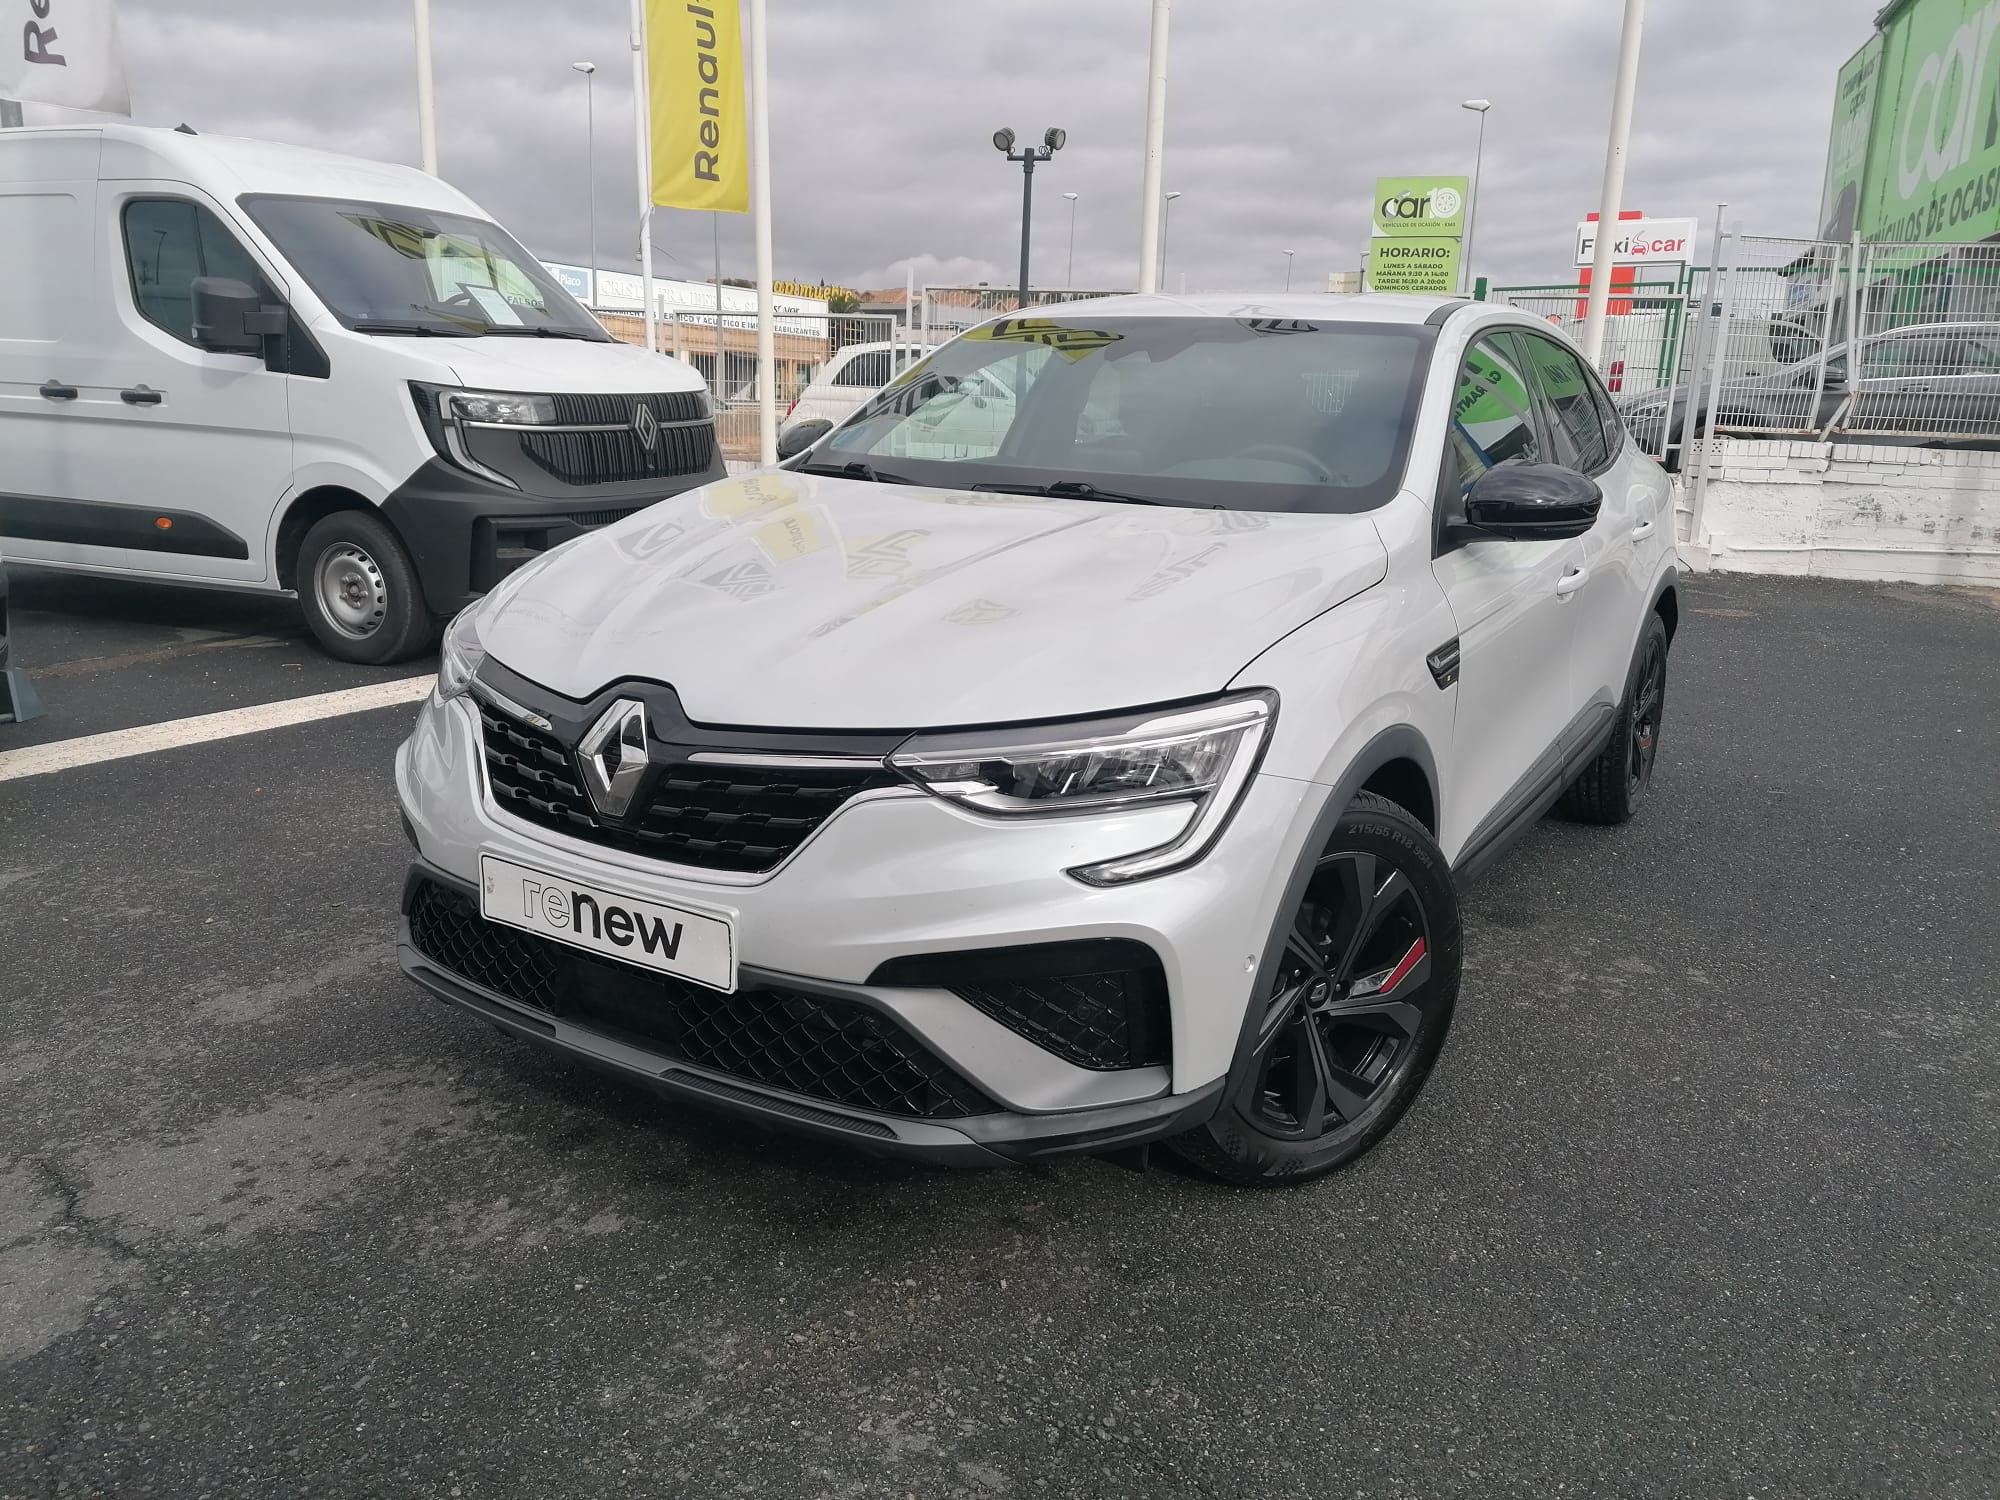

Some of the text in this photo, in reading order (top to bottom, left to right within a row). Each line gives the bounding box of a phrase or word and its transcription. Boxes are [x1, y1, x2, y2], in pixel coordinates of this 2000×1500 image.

[687, 0, 720, 182] Renaul
[1898, 0, 2000, 200] car
[1925, 193, 1947, 237] DE
[1380, 248, 1450, 258] HORARIO:
[1581, 237, 1686, 254] Fxi car
[560, 274, 581, 286] Placo
[697, 316, 703, 325] Y
[703, 317, 740, 328] ACUTICO
[1348, 823, 1392, 837] 215/55
[1391, 830, 1414, 849] R18
[522, 878, 684, 961] renew
